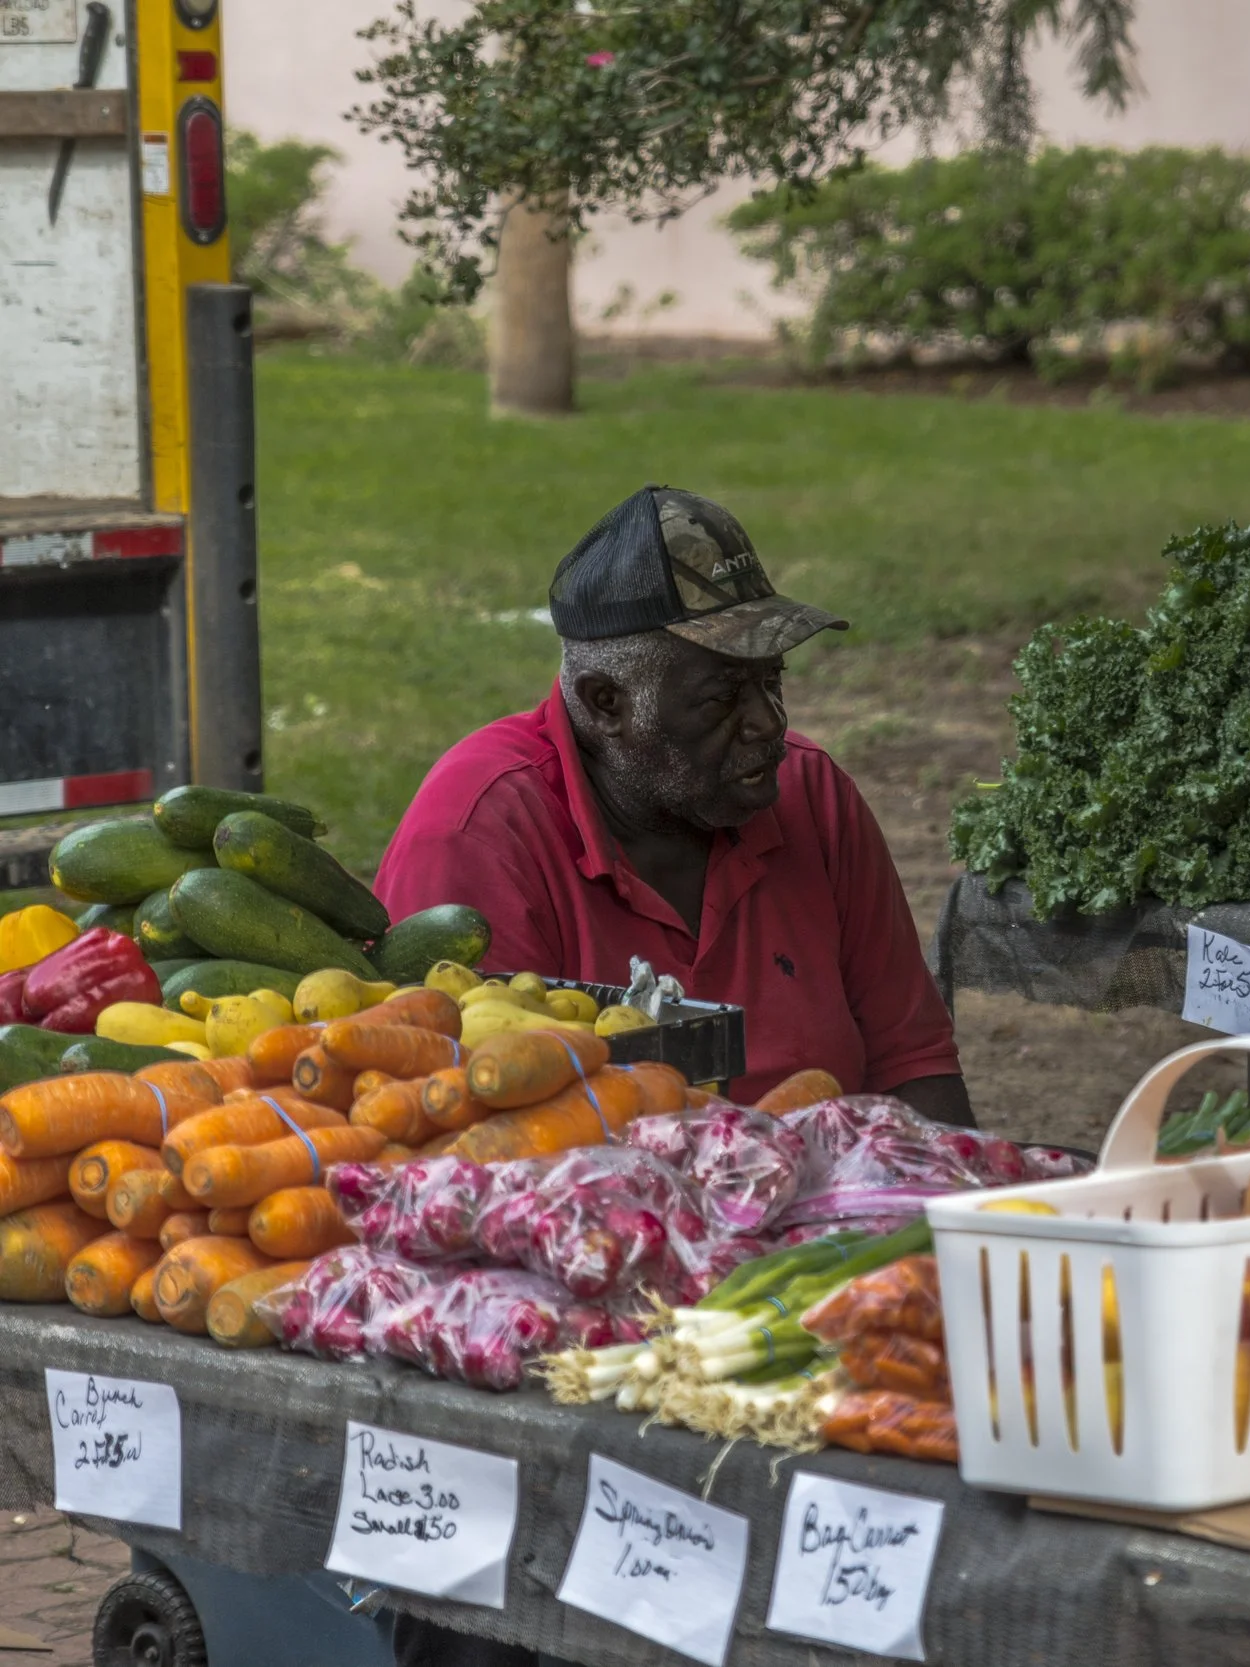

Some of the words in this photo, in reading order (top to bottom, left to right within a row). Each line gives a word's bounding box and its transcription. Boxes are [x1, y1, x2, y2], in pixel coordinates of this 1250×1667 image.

[1202, 930, 1243, 965] Kale
[55, 1389, 107, 1429] Carrot
[86, 1376, 143, 1409] Bunch
[350, 1431, 430, 1473] Radish
[351, 1511, 413, 1536] Small
